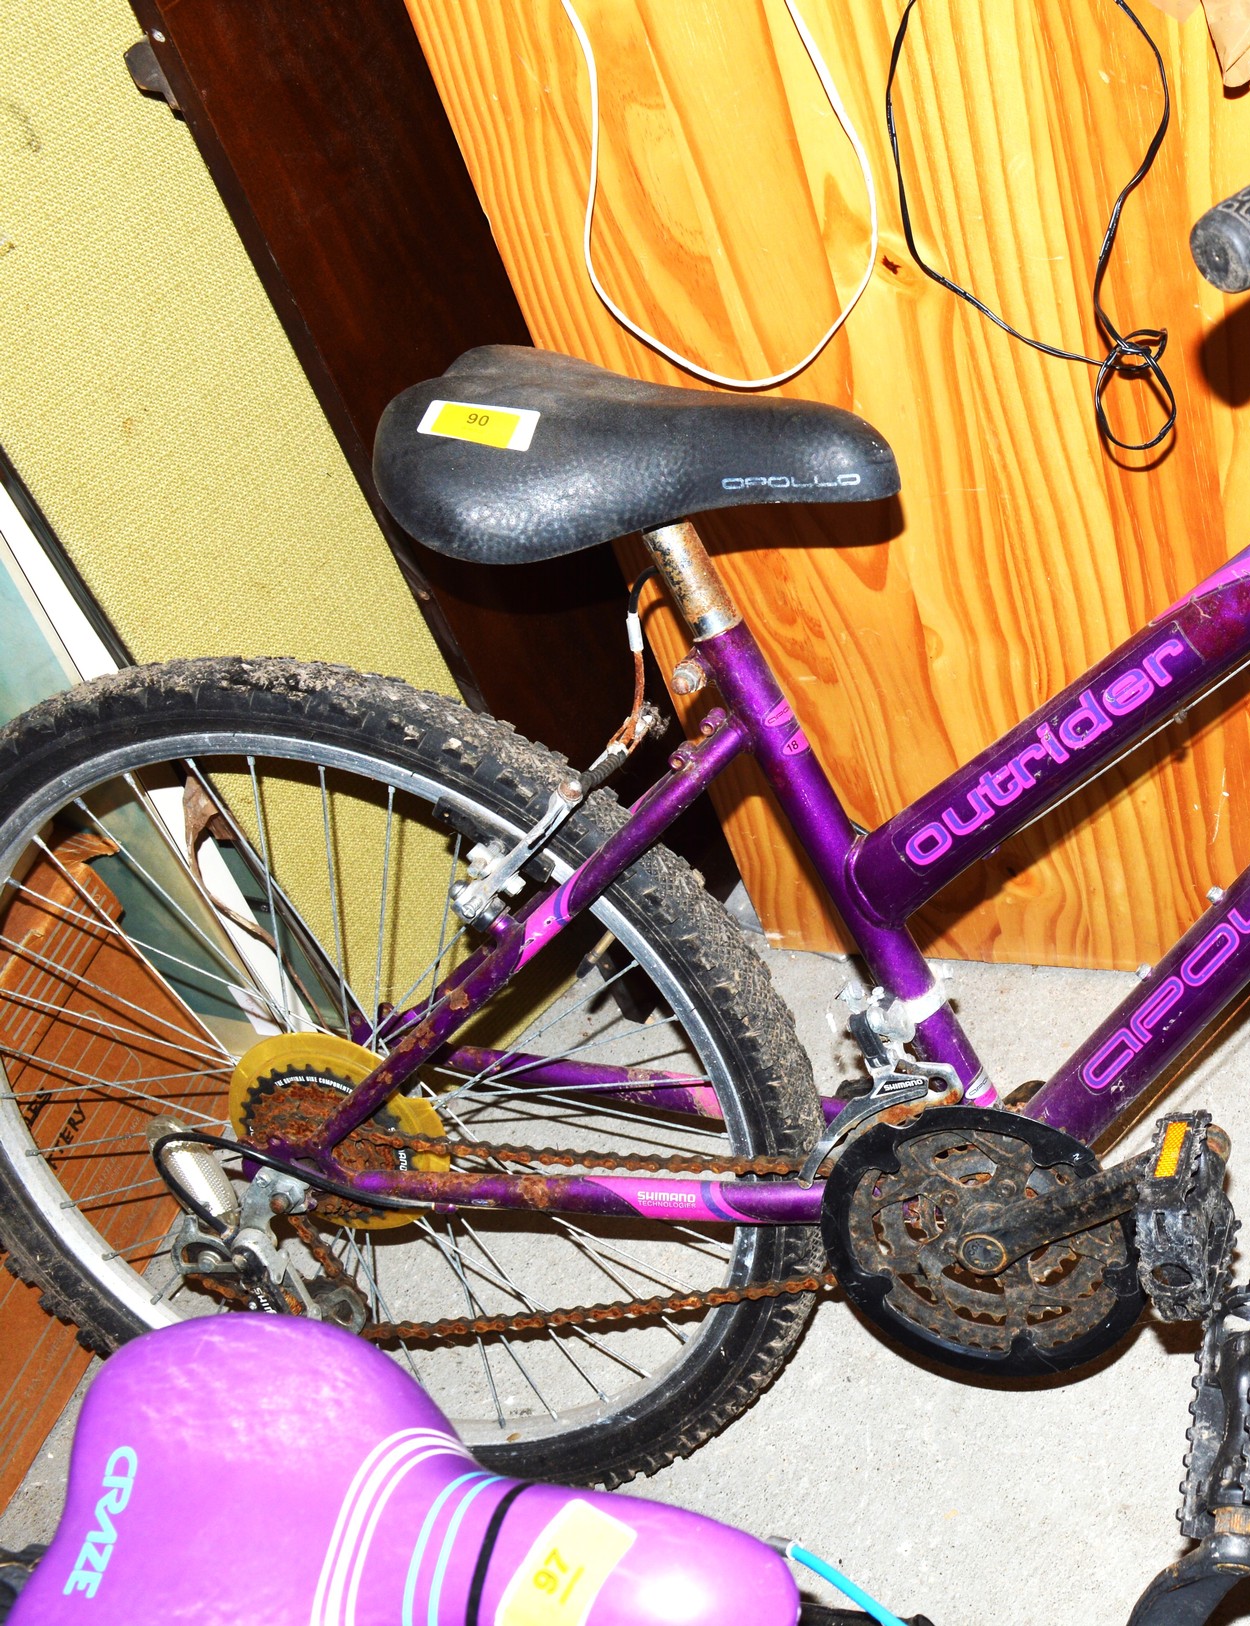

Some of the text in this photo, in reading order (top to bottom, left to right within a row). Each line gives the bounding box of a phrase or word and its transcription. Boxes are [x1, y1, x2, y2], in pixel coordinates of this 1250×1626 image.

[467, 413, 490, 427] 90
[721, 473, 861, 490] APOLLO
[786, 740, 799, 752] 18
[905, 638, 1184, 866] outrider
[883, 1079, 924, 1092] SHIMANO
[637, 1191, 696, 1203] SHIMANO
[638, 1200, 697, 1209] TECHNOLOGIES
[63, 1445, 138, 1599] CRAZE
[532, 1547, 569, 1595] 97
